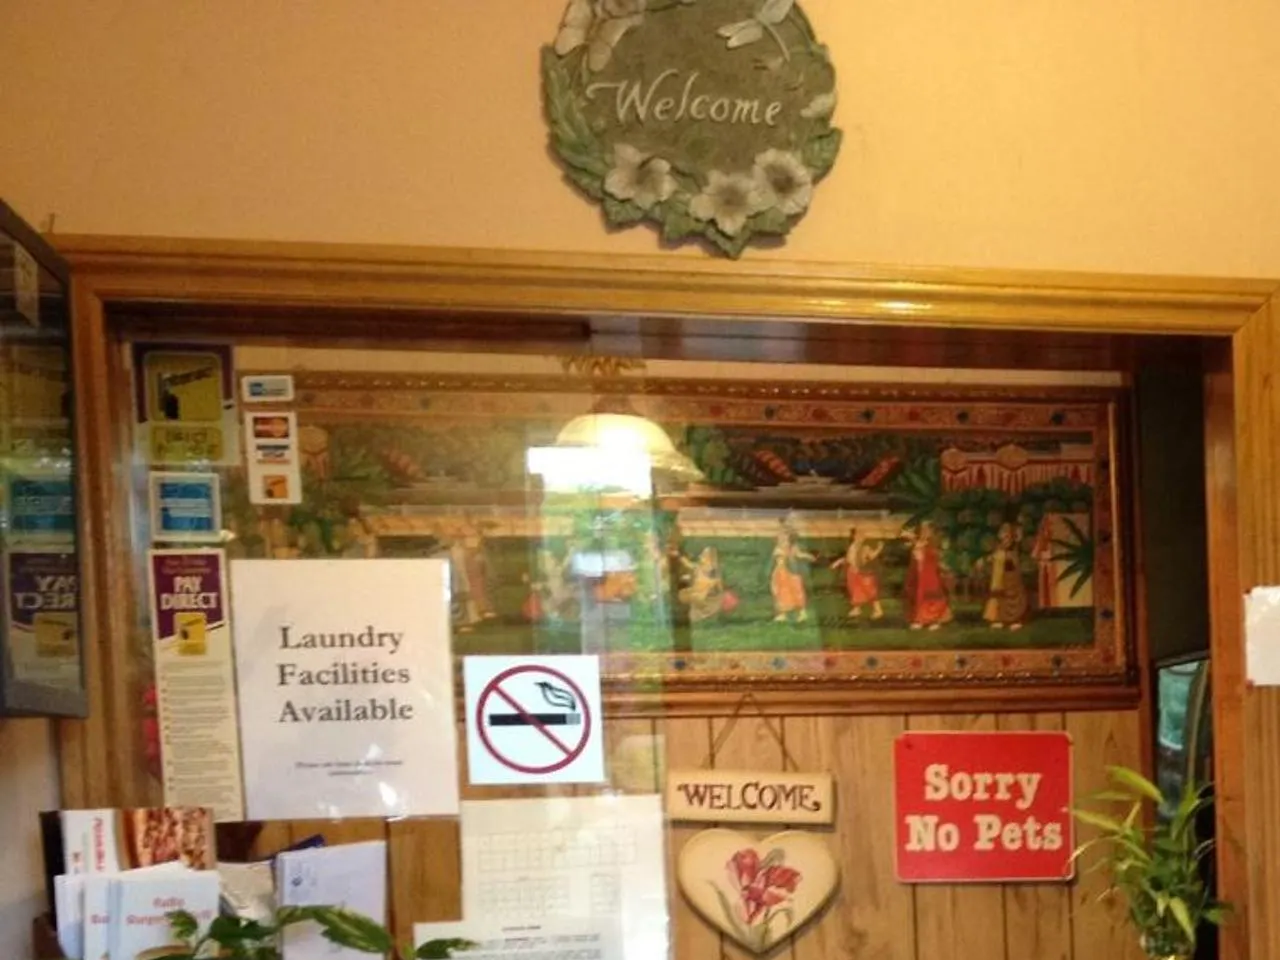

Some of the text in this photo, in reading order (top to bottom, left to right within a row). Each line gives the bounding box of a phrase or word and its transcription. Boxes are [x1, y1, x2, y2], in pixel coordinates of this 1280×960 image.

[586, 69, 783, 125] Welcome
[173, 575, 203, 593] PAY
[160, 592, 218, 610] DIRECT
[279, 625, 404, 654] Laundry
[277, 662, 411, 686] Facilities
[276, 698, 414, 723] Available
[677, 781, 822, 812] WELCOME
[924, 764, 1043, 810] Sorry
[905, 813, 1063, 852] No Pets
